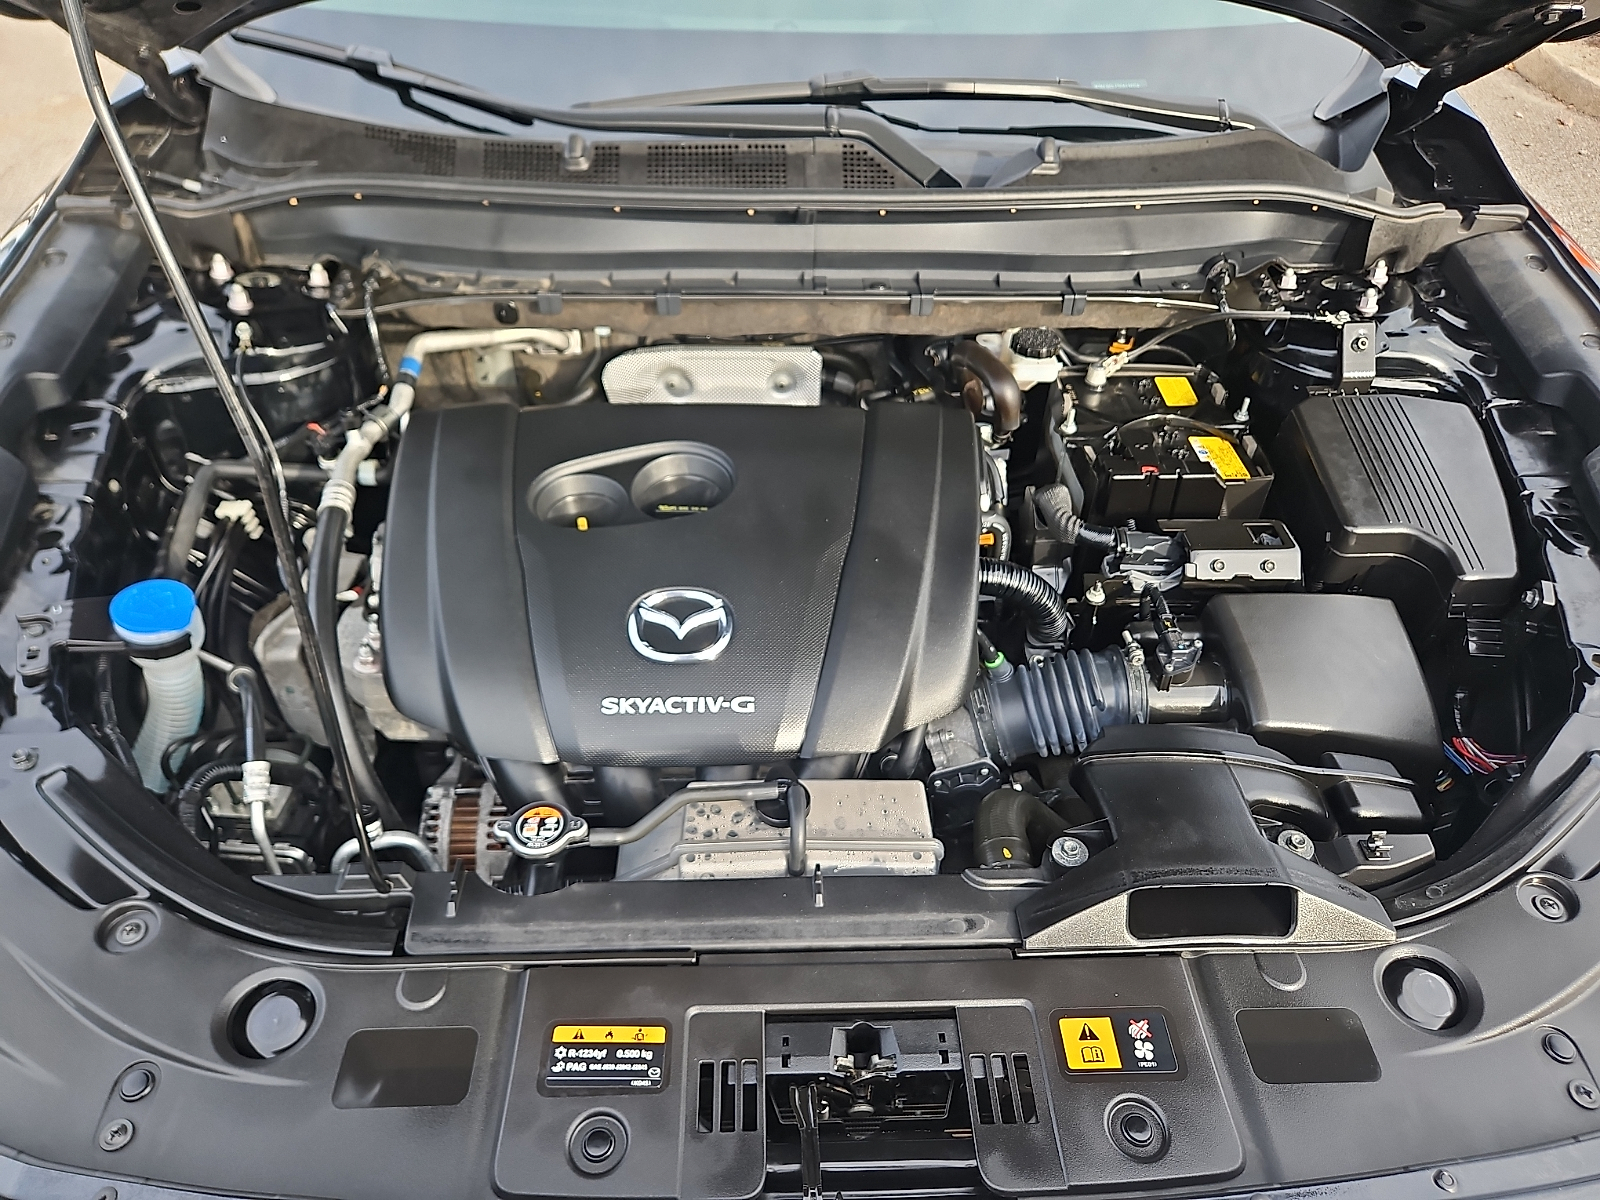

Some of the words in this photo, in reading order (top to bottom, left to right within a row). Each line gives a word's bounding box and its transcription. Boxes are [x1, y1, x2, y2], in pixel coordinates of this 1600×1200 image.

[600, 696, 755, 715] SKYACTIV-G
[567, 1048, 607, 1060] R-1234yf
[616, 1048, 640, 1058] 0.500
[640, 1048, 653, 1060] kg
[565, 1062, 587, 1072] PAG
